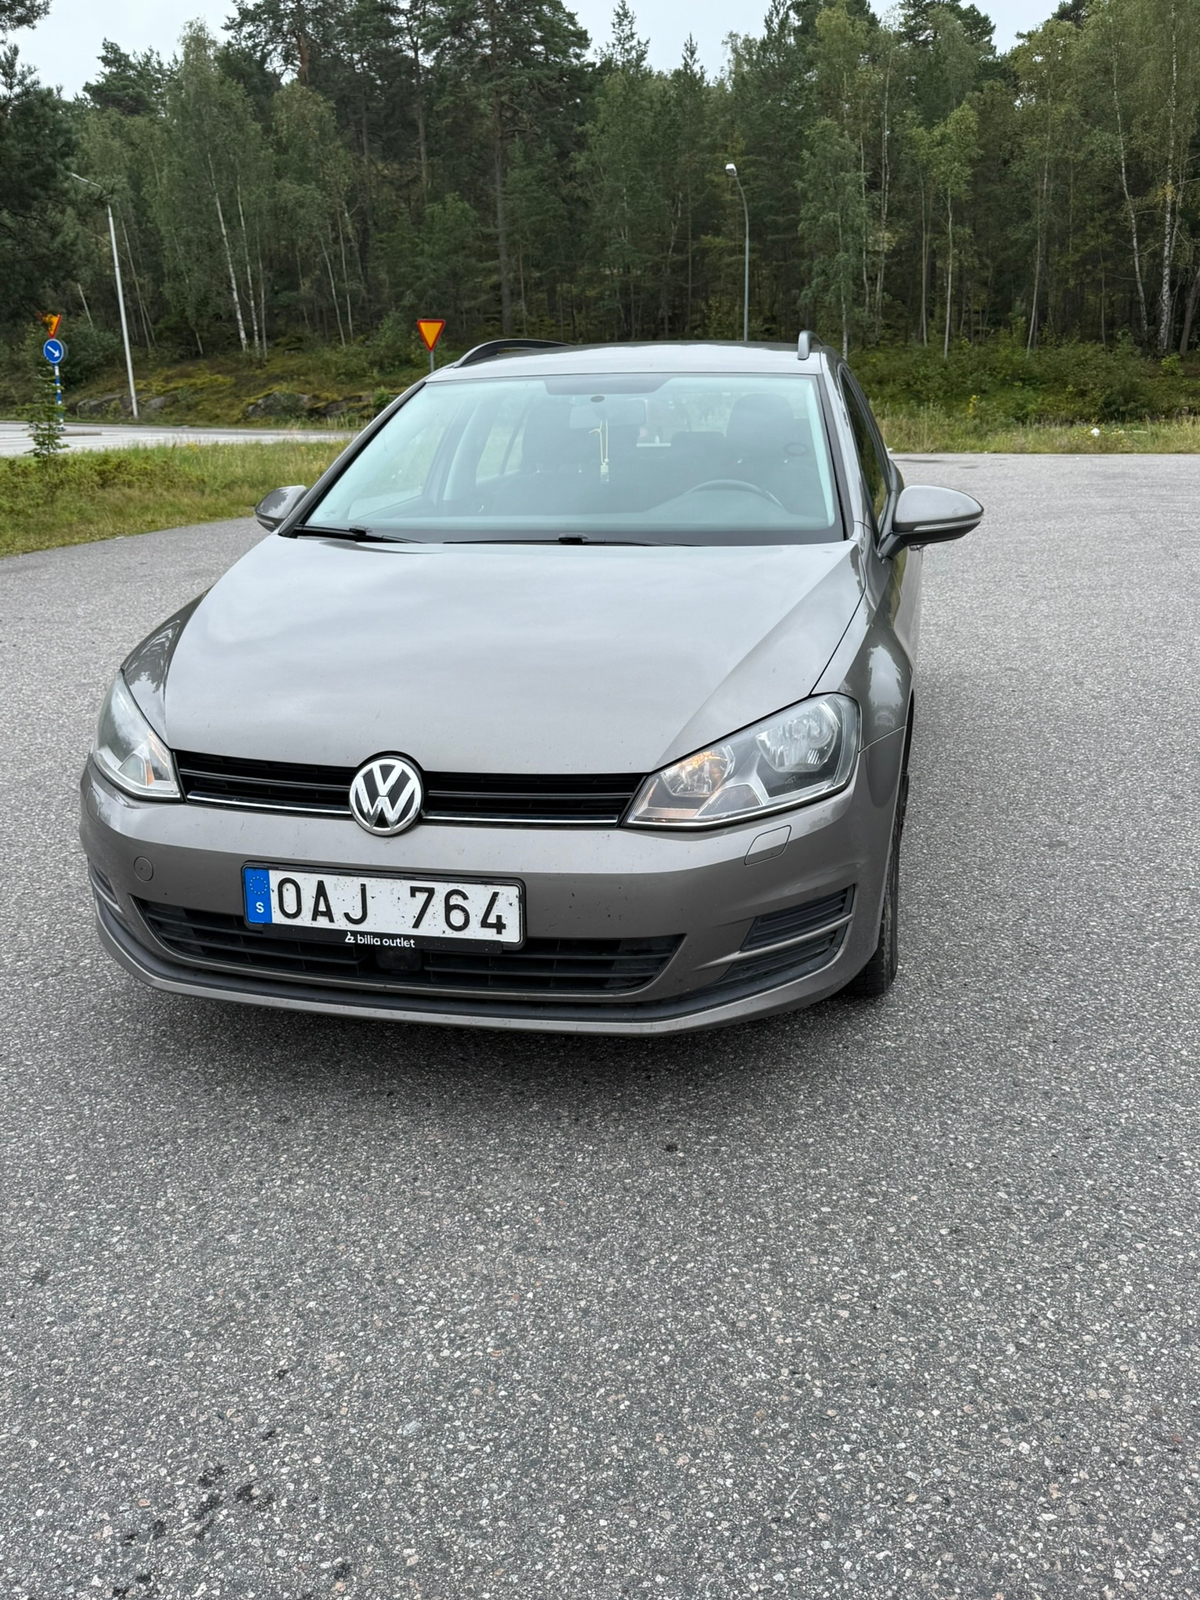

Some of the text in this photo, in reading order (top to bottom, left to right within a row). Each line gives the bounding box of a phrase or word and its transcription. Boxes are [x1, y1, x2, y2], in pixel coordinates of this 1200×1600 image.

[350, 759, 421, 831] VW
[255, 902, 265, 914] S
[278, 877, 507, 935] OAJ 764
[357, 934, 415, 948] bilia outlet
